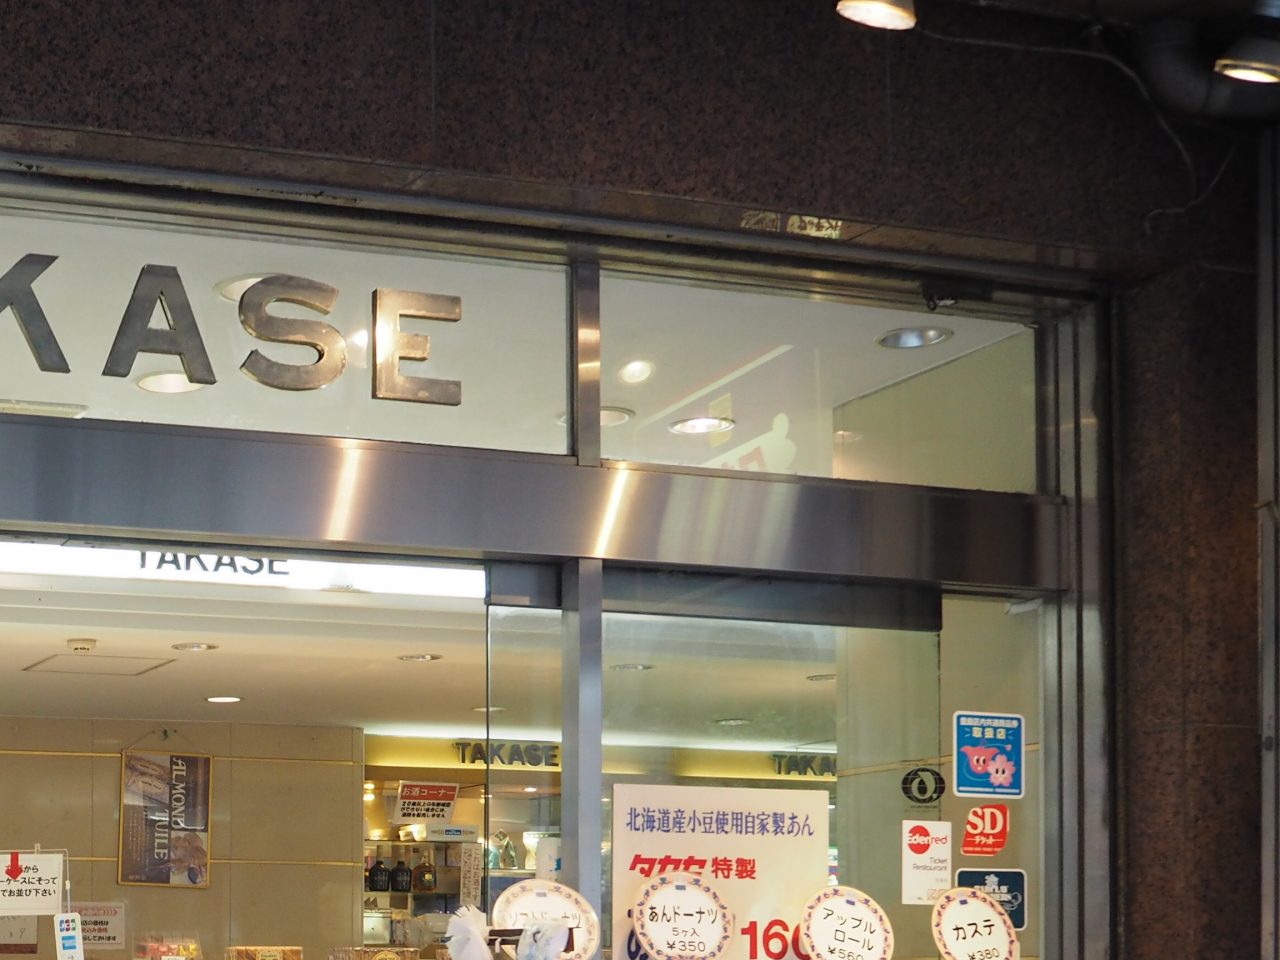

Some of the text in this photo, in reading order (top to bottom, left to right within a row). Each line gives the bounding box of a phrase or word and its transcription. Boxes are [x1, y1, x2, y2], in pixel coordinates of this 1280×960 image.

[455, 742, 560, 767] TAKASE
[171, 757, 187, 830] ALMOND
[401, 786, 456, 797] お酒コーナー
[625, 807, 815, 837] 北海道産小豆使用自家製あん
[965, 807, 1004, 835] SD
[906, 833, 949, 845] Edenred
[710, 856, 757, 880] 特製
[912, 863, 948, 871] Restaurant
[929, 856, 948, 864] Ticket
[648, 906, 718, 925] あんドーナツ
[823, 907, 877, 935] アップル
[834, 929, 875, 951] ロール
[952, 918, 996, 942] カステ
[666, 940, 707, 952] ¥350
